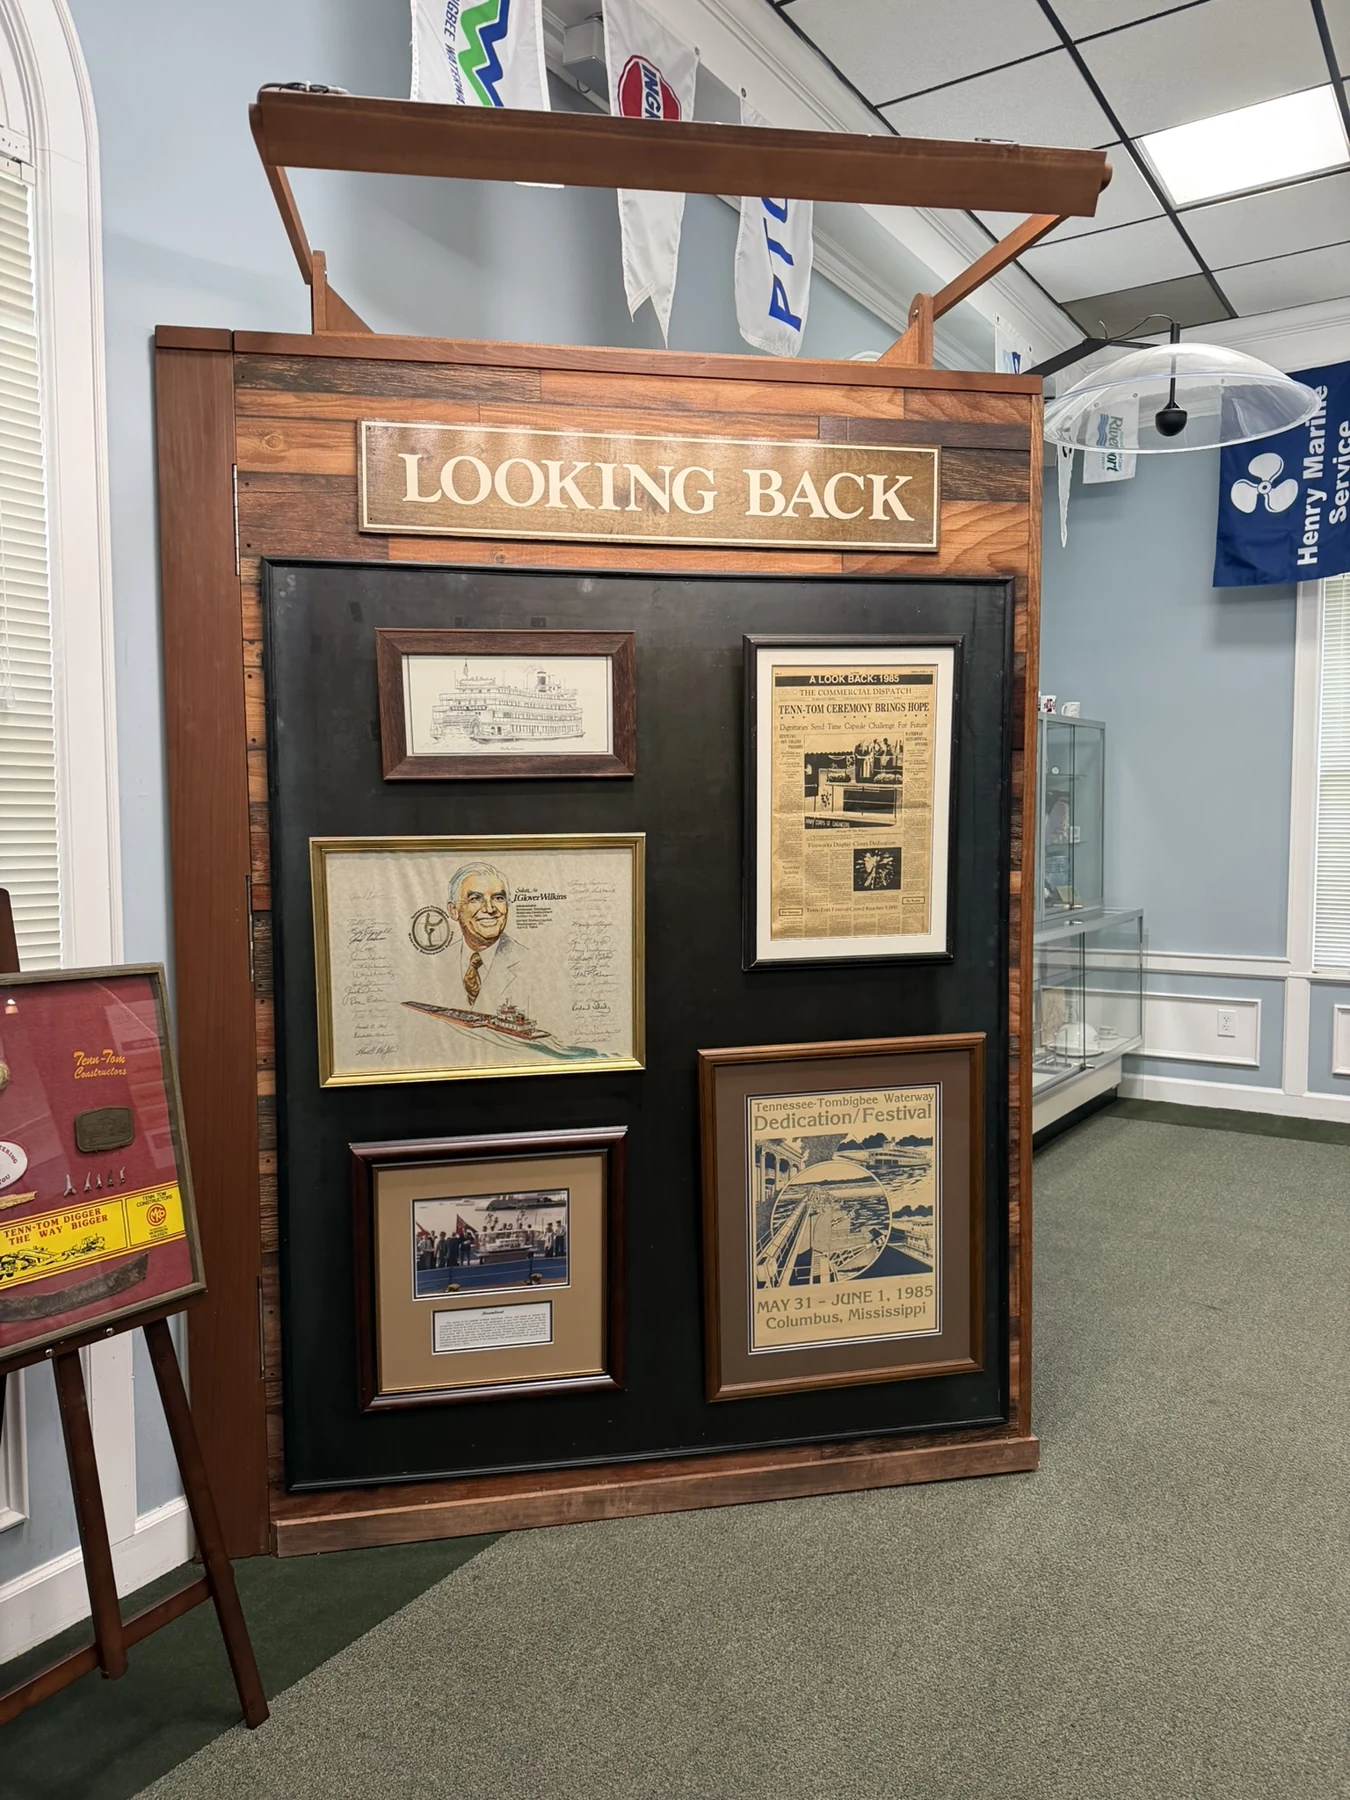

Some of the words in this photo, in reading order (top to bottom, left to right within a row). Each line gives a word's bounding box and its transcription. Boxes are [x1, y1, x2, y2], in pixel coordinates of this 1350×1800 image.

[444, 0, 461, 41] IGBEE
[445, 43, 466, 105] WATERWA
[1106, 415, 1124, 473] Riverort
[1329, 420, 1350, 525] Service
[398, 453, 718, 515] LOOKING
[742, 468, 915, 522] BACK
[1297, 488, 1327, 566] Henry
[800, 689, 816, 697] THE
[818, 688, 871, 697] COMMERCIAL
[873, 687, 912, 695] DISPATCH
[809, 675, 816, 684] A
[818, 675, 846, 684] LOOK
[848, 674, 877, 684] BACK:
[880, 674, 899, 683] 1985
[778, 704, 824, 715] TENN-TOM
[826, 703, 872, 714] CEREMONY
[875, 702, 906, 713] BRINGS
[908, 701, 930, 712] HOPE
[780, 723, 808, 732] Dignitaries
[844, 722, 866, 731] Capsule
[868, 721, 895, 730] Challenge
[898, 721, 907, 729] For
[73, 1049, 126, 1067] Tenn-Tom
[74, 1066, 127, 1079] Constructors
[754, 1103, 932, 1131] Dedication/Festival
[755, 1095, 879, 1113] Tennessee-Tombigbee
[883, 1092, 935, 1104] Waterway
[3, 1217, 60, 1239] TENN-TOM
[63, 1207, 102, 1224] DIGGER
[9, 1234, 31, 1246] THE
[39, 1225, 63, 1239] WAY
[71, 1214, 108, 1231] BIGGER
[756, 1298, 791, 1314] MAY
[794, 1296, 812, 1310] 31
[831, 1290, 873, 1307] JUNE
[877, 1289, 890, 1302] 1,
[897, 1285, 934, 1300] 1985
[765, 1311, 843, 1330] Columbus,
[848, 1301, 927, 1322] Mississippi
